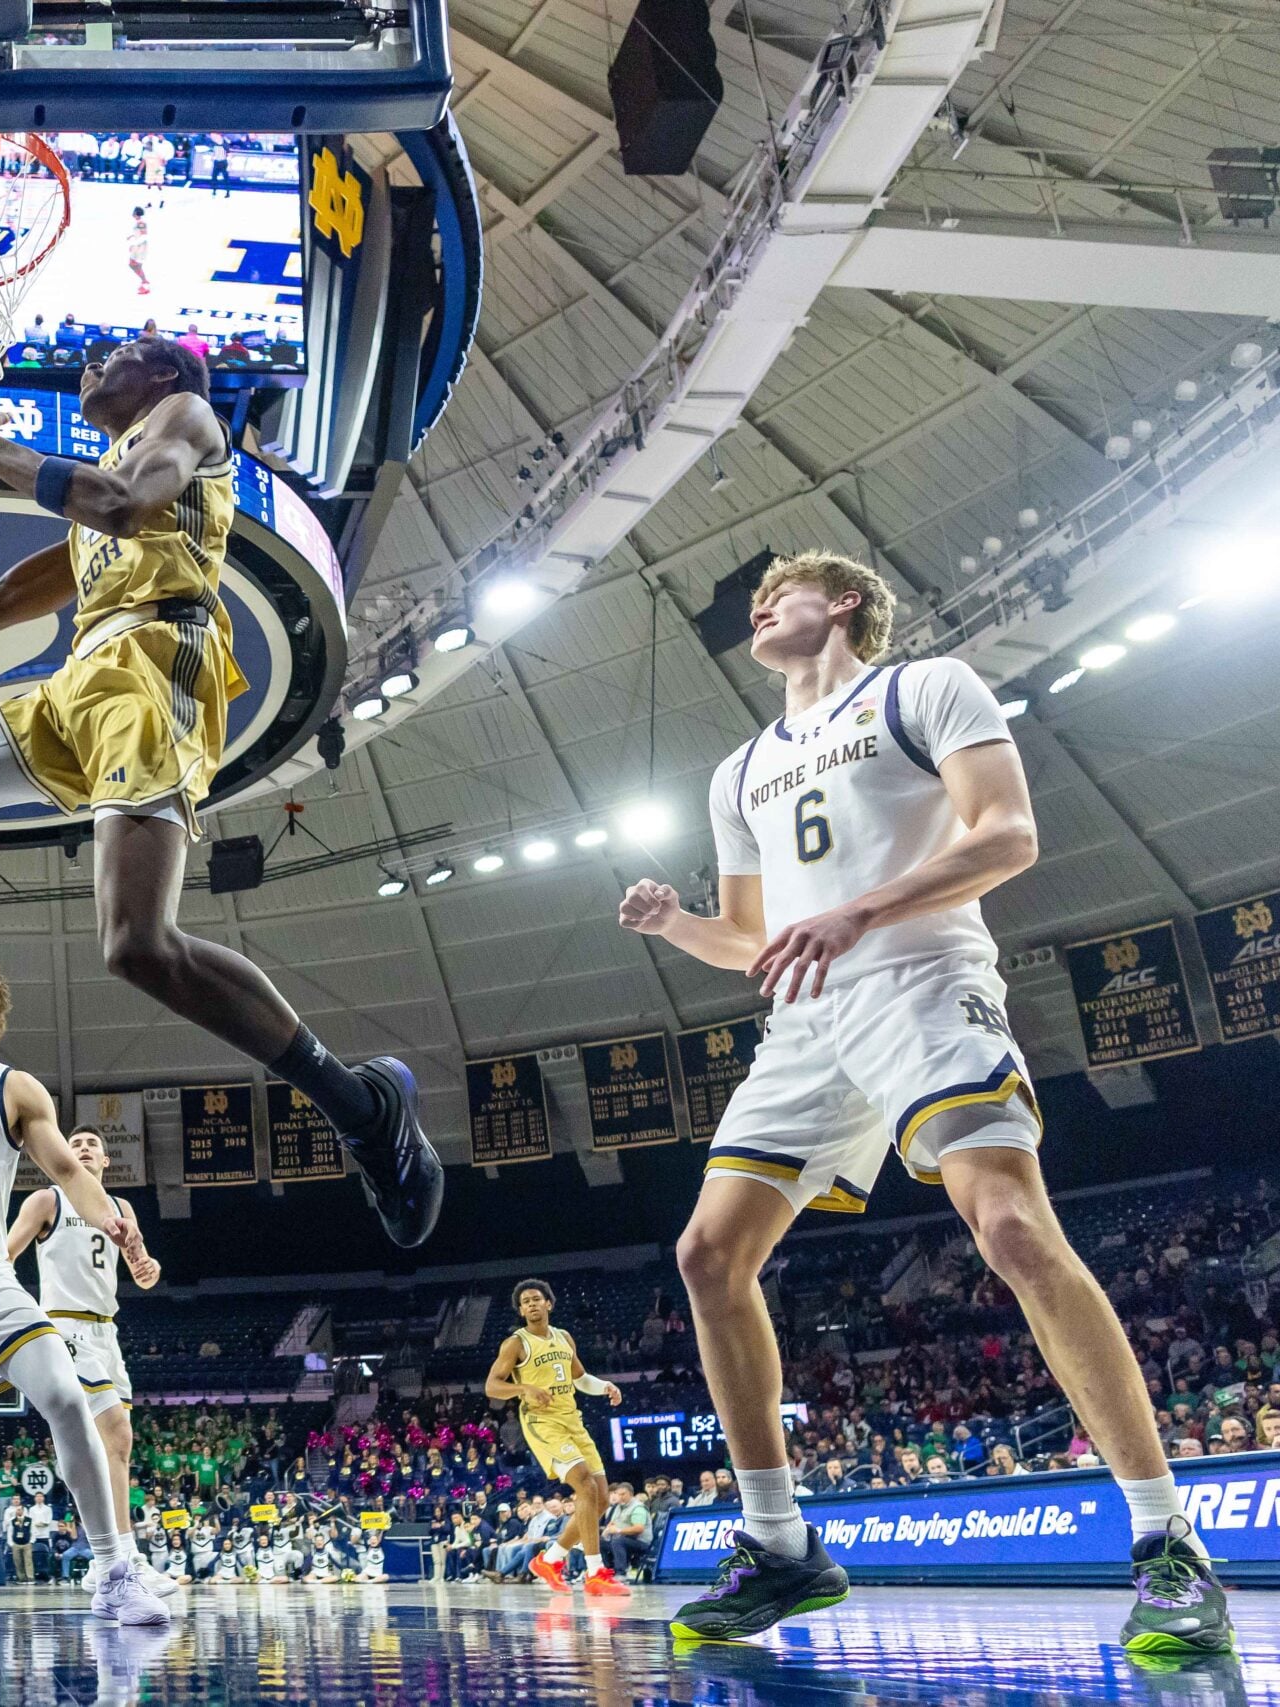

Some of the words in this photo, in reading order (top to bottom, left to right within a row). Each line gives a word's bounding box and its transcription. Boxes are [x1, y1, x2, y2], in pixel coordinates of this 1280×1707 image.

[71, 427, 101, 442] REB
[72, 443, 100, 458] FLS
[78, 537, 123, 604] ECH
[750, 764, 805, 812] NOTRE
[816, 735, 879, 776] DAME
[794, 787, 834, 866] 6
[1098, 966, 1158, 996] ACC
[1081, 983, 1179, 1012] TOURNAMENT
[1095, 997, 1169, 1020] CHAMPION
[1098, 1034, 1130, 1048] 2016
[1149, 1023, 1181, 1039] 2017
[687, 1066, 749, 1086] TOURNAME
[590, 1078, 665, 1096] TOURNAMENT
[289, 1112, 318, 1120] NCAA
[187, 1127, 216, 1136] FINAL
[221, 1125, 248, 1133] FOUR
[273, 1121, 304, 1131] FINAL
[106, 1134, 140, 1144] MPION
[190, 1139, 212, 1149] 2015
[224, 1137, 246, 1147] 2018
[277, 1134, 298, 1144] 1997
[312, 1131, 333, 1141] 2001
[595, 1133, 627, 1145] WOMEN'S
[630, 1128, 674, 1141] BASKETBALL
[191, 1151, 213, 1160] 2019
[278, 1145, 298, 1155] 2011
[312, 1143, 334, 1152] 2012
[278, 1156, 300, 1166] 2013
[313, 1154, 335, 1163] 2014
[185, 1172, 214, 1181] WOMEN'S
[216, 1171, 254, 1180] BASKETBALL
[273, 1167, 302, 1176] WOMEN'S
[91, 1234, 105, 1269] 2
[552, 1363, 566, 1382] 3
[627, 1417, 652, 1425] NOTRE
[654, 1415, 676, 1423] DAME
[691, 1415, 723, 1432] 15:2
[659, 1426, 683, 1457] 10
[1175, 1480, 1257, 1529] IRE
[673, 1520, 718, 1551] TIRE
[824, 1519, 862, 1549] Way
[861, 1516, 892, 1543] Tire
[894, 1512, 963, 1546] Buying
[961, 1506, 1041, 1539] Should
